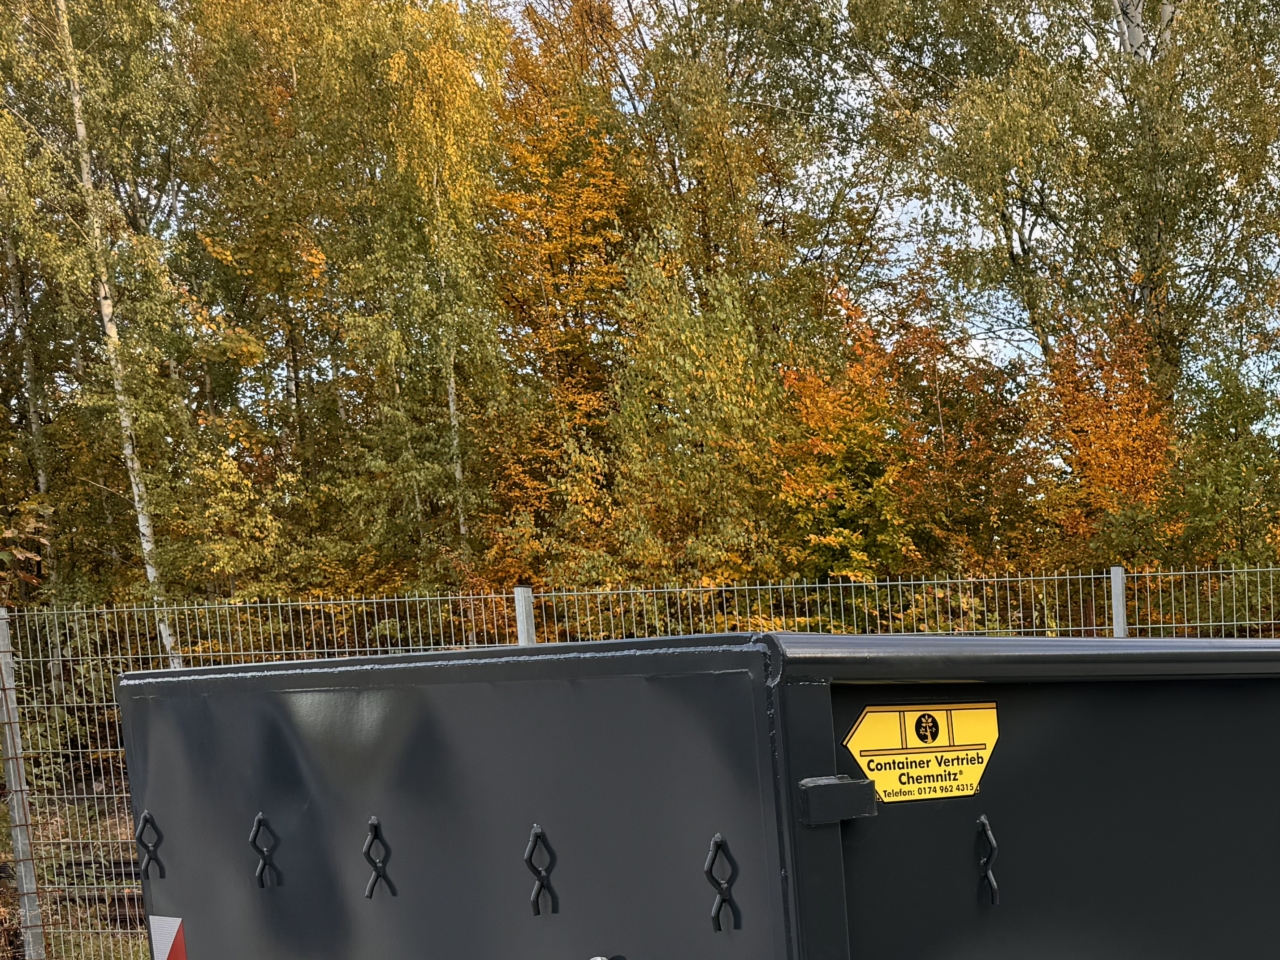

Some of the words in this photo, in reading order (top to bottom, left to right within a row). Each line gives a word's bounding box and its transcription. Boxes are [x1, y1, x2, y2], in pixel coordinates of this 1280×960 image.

[867, 757, 931, 772] Container
[935, 752, 984, 767] Vertrieb
[883, 788, 915, 798] Telefon:
[917, 785, 937, 795] 0174
[939, 784, 954, 794] 962
[955, 783, 974, 792] 4315
